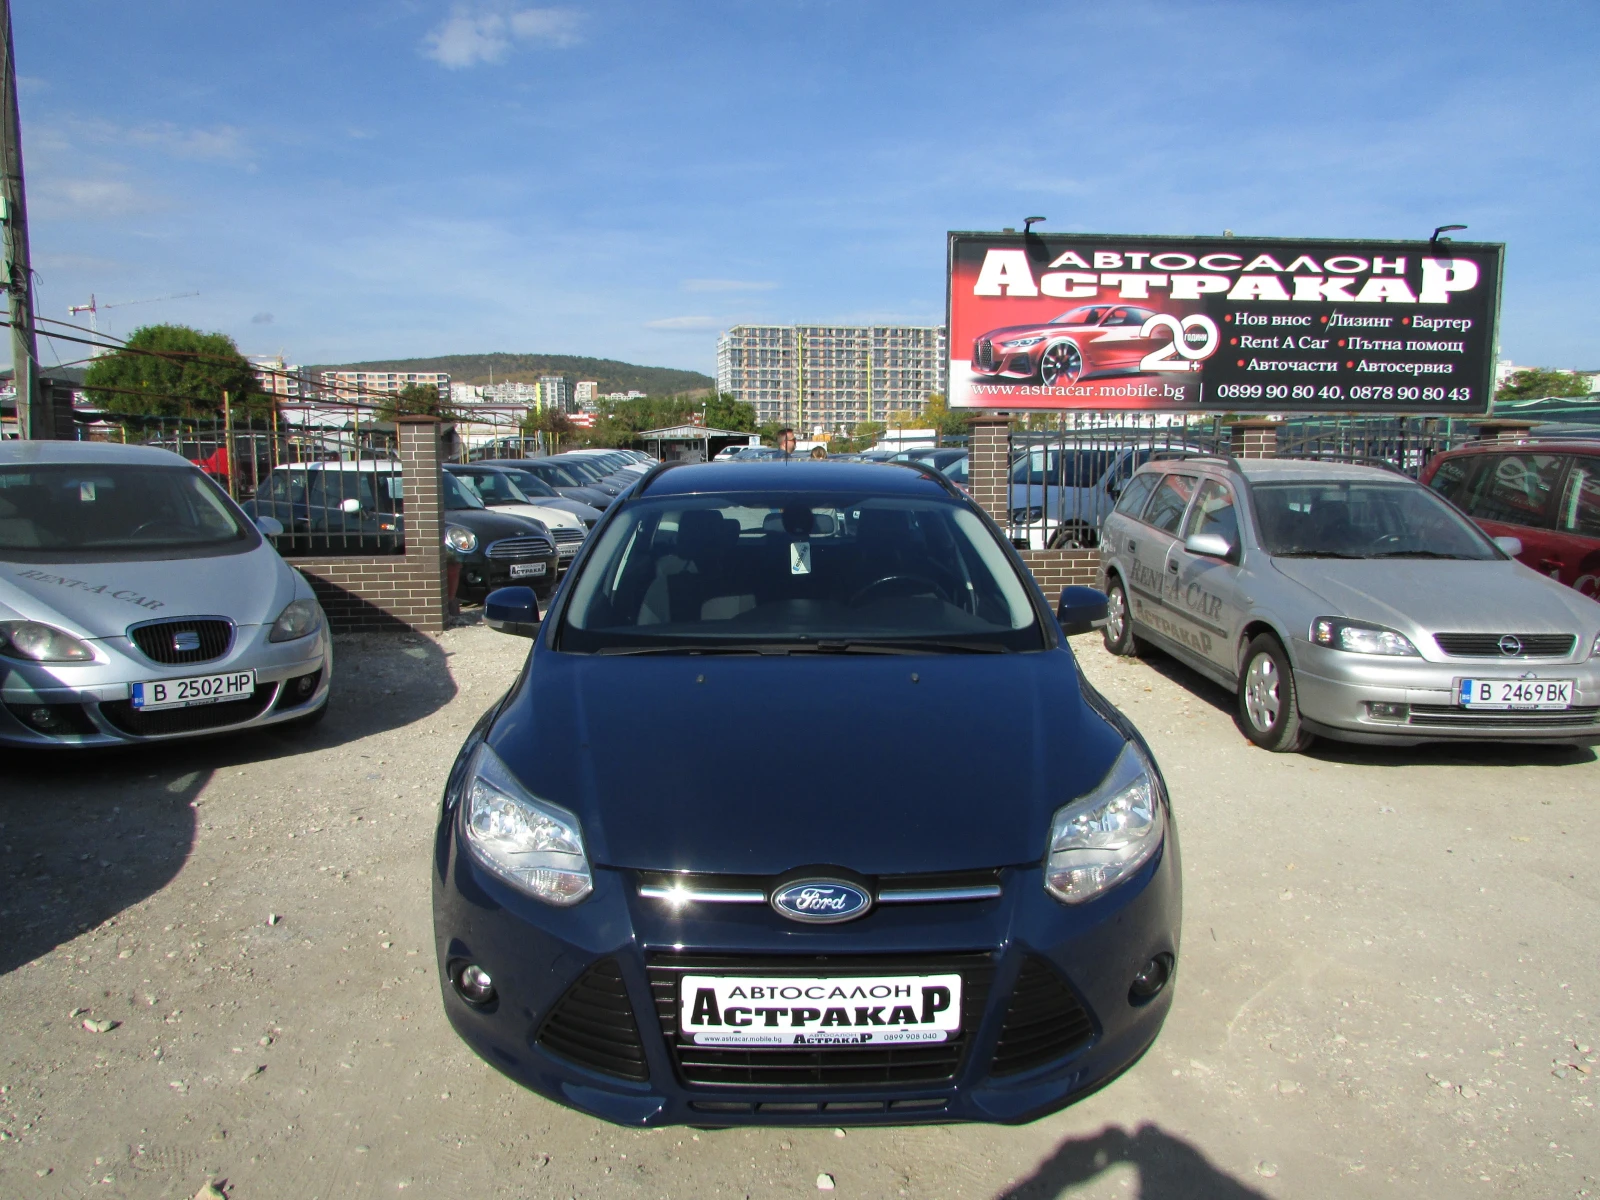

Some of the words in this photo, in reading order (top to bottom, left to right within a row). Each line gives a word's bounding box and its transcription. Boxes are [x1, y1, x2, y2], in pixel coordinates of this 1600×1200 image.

[1047, 251, 1406, 275] АВТОСАЛОН
[1234, 312, 1268, 326] Нов
[1271, 315, 1312, 326] внос
[1330, 312, 1393, 328] Лизинг
[1411, 315, 1472, 332] Бартер
[1240, 336, 1280, 349] Rent
[1282, 336, 1297, 349] A
[1298, 336, 1329, 350] Car
[1348, 337, 1403, 351] Пътна
[1406, 341, 1464, 353] помощ
[1246, 359, 1338, 372] Авточасти
[1356, 359, 1453, 376] Автосервиз
[971, 382, 1185, 400] www.astracar.mobile.bg
[1217, 384, 1262, 399] 0899
[1265, 385, 1288, 399] 90
[1291, 385, 1314, 399] 80
[1317, 385, 1345, 400] 40,
[1349, 386, 1393, 400] 0878
[1396, 386, 1419, 400] 90
[1422, 387, 1445, 400] 80
[1447, 387, 1471, 400] 43
[17, 569, 165, 610] RENT-A-CAR
[154, 684, 168, 701] B
[177, 678, 223, 699] 2502
[226, 674, 251, 693] HP
[1480, 684, 1492, 701] B
[1502, 684, 1544, 701] 2469
[1546, 684, 1568, 701] BK
[795, 887, 847, 910] Ford
[728, 985, 911, 1000] АВТОСАЛОН
[704, 1035, 782, 1044] www.astracar.mobile.bg
[922, 1032, 937, 1040] 040
